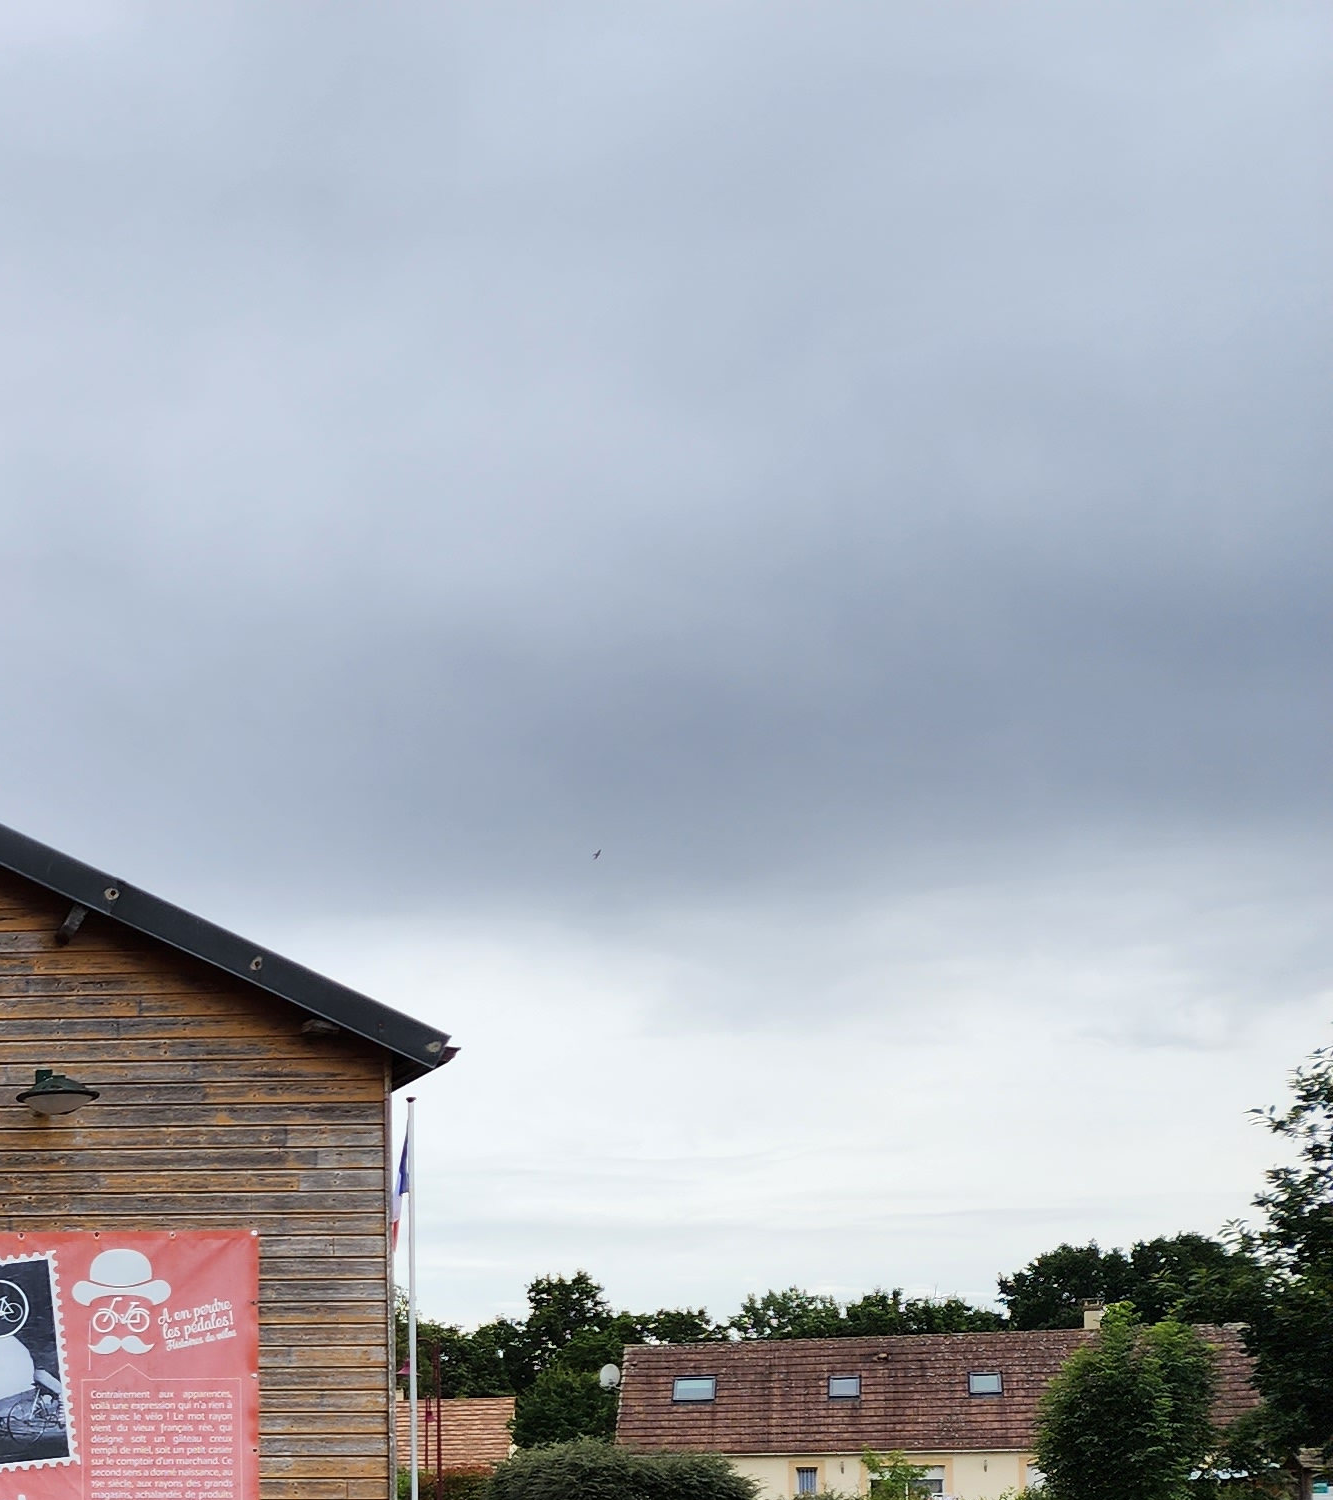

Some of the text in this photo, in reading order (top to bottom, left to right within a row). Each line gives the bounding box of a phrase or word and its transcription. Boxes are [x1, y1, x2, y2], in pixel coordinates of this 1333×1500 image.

[157, 1297, 233, 1325] A en perdre
[162, 1323, 181, 1339] les
